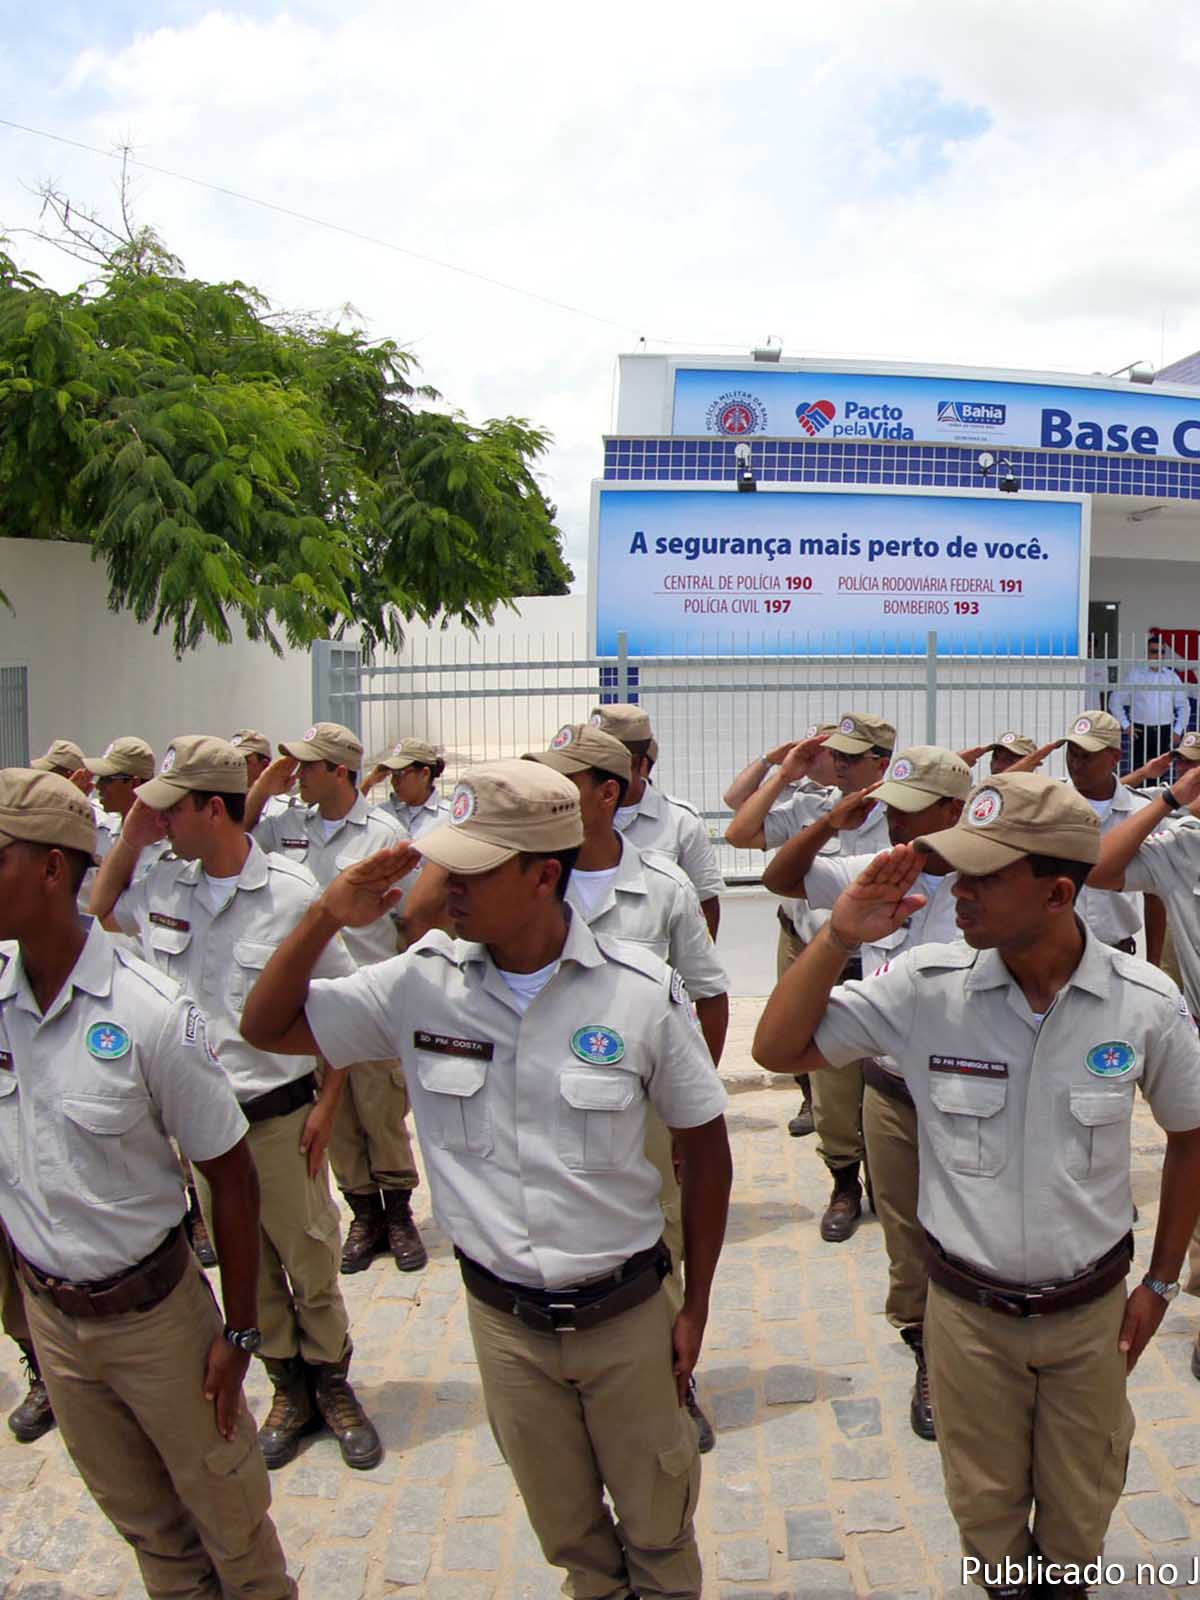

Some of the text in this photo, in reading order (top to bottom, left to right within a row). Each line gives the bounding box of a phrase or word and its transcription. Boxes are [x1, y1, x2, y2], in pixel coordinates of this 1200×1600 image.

[844, 401, 903, 420] Pacto
[962, 404, 1003, 419] Bahia
[1040, 408, 1159, 455] Base
[629, 531, 1049, 562] A segurança mais perto de você.
[664, 573, 812, 591] CENTRAL DE POLÍCIA 190
[838, 574, 1023, 593] POLÍCIA RODOVIÁRIA FEDERAL 191
[684, 596, 792, 614] POLÍCIA CIVIL 197
[883, 600, 980, 615] BOMBEIROS 193
